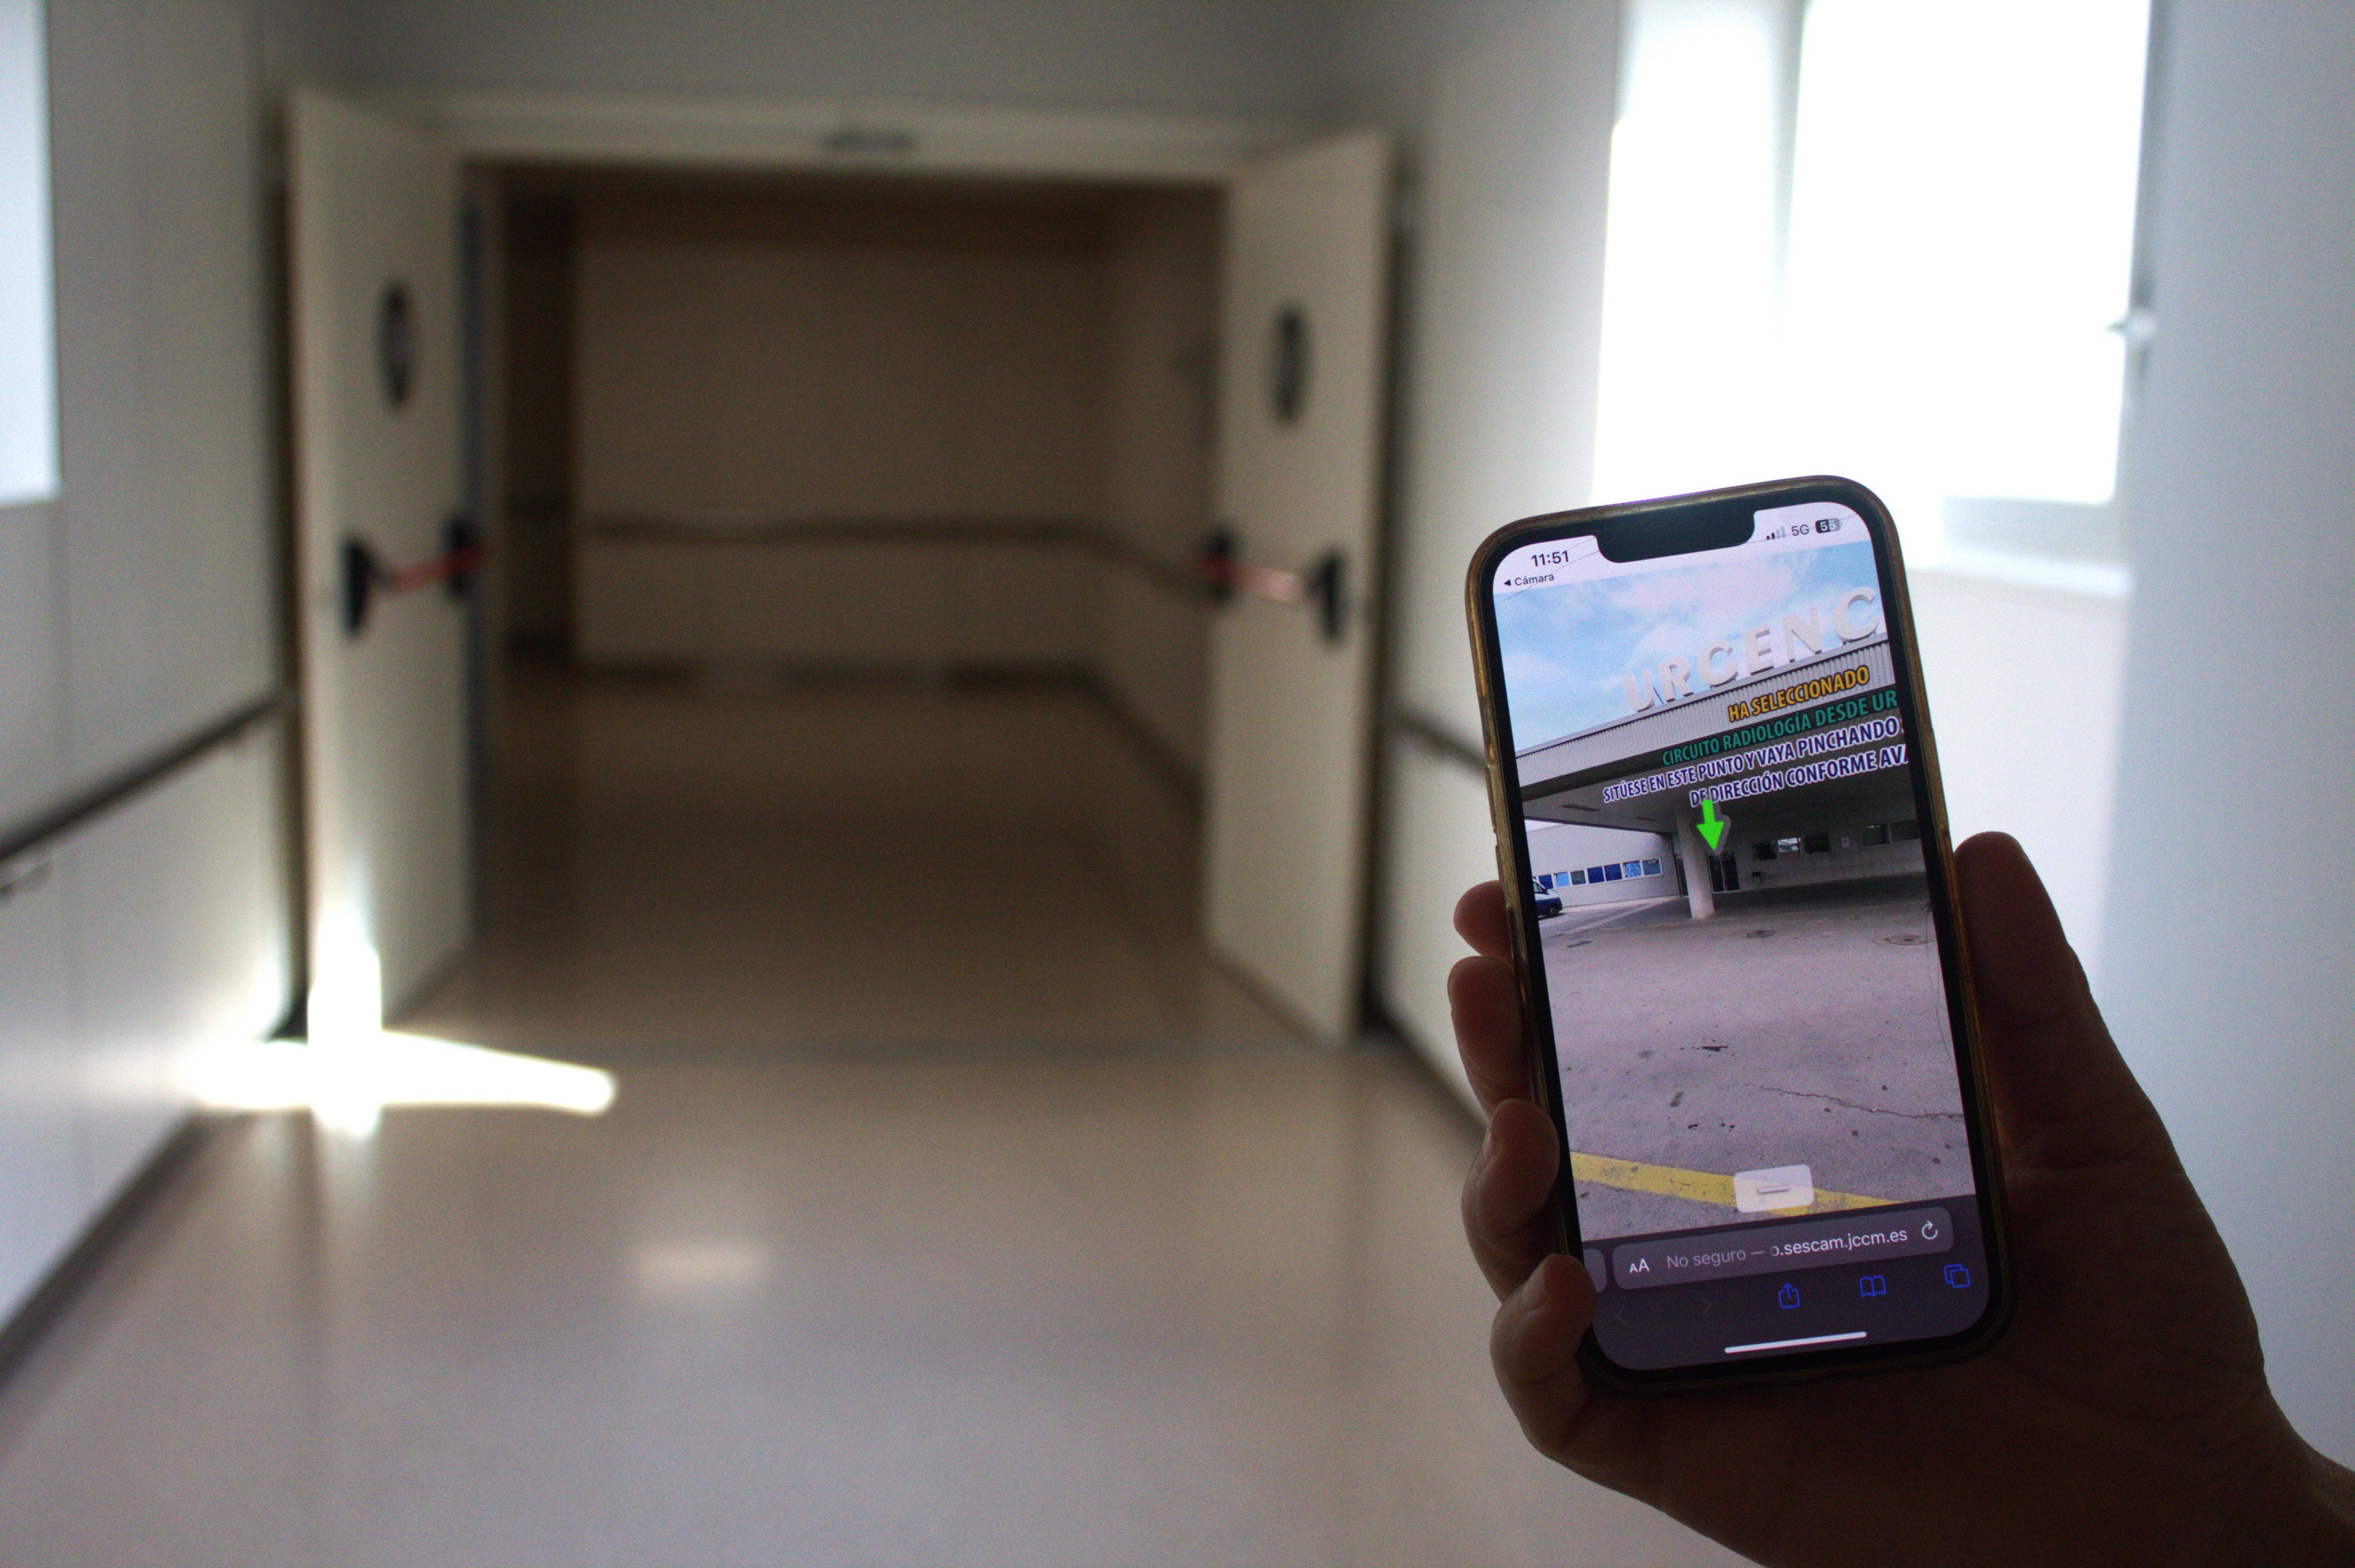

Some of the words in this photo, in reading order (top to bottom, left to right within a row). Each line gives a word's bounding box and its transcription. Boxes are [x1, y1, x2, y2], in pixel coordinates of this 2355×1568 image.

[1791, 524, 1809, 536] 5G
[1531, 550, 1569, 566] 11:51
[1515, 574, 1554, 585] Cámara
[1728, 701, 1750, 722] HA
[1751, 665, 1870, 716] SELECCIONADO
[1662, 738, 1719, 766] CIRCUITO
[1722, 712, 1811, 751] RADIOLOGÍA
[1814, 697, 1868, 727] DESDE
[1872, 690, 1898, 712] UR
[1604, 779, 1648, 803] SITÚESE
[1648, 773, 1666, 793] EN
[1666, 765, 1697, 788] ESTE
[1698, 754, 1744, 781] PUNTO
[1744, 751, 1755, 769] Y
[1756, 742, 1796, 766] VAYA
[1796, 716, 1899, 758] PINCHANDO
[1709, 770, 1784, 803] DIRECCIÓN
[1785, 751, 1877, 787] CONFORME
[1667, 1255, 1688, 1269] No
[1693, 1248, 1746, 1267] seguro
